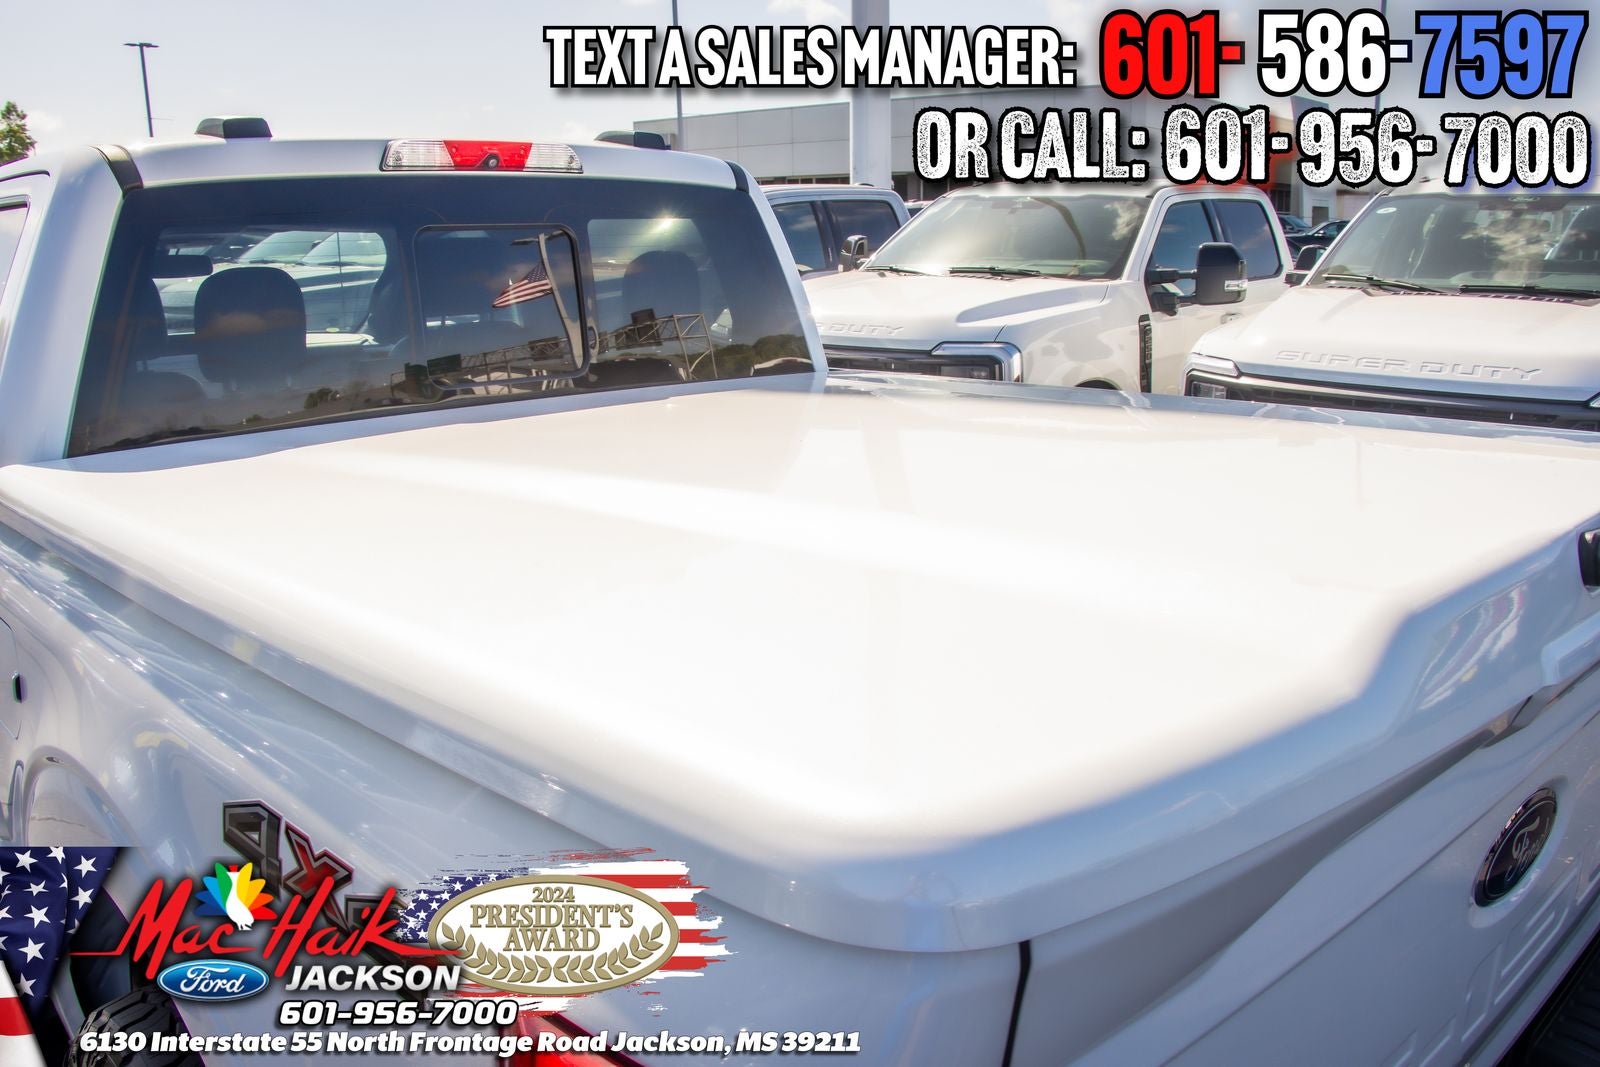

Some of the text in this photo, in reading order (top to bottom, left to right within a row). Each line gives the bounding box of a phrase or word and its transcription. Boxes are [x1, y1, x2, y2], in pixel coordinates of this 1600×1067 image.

[830, 322, 904, 336] DUTY
[1275, 350, 1543, 381] SUPER DUTY
